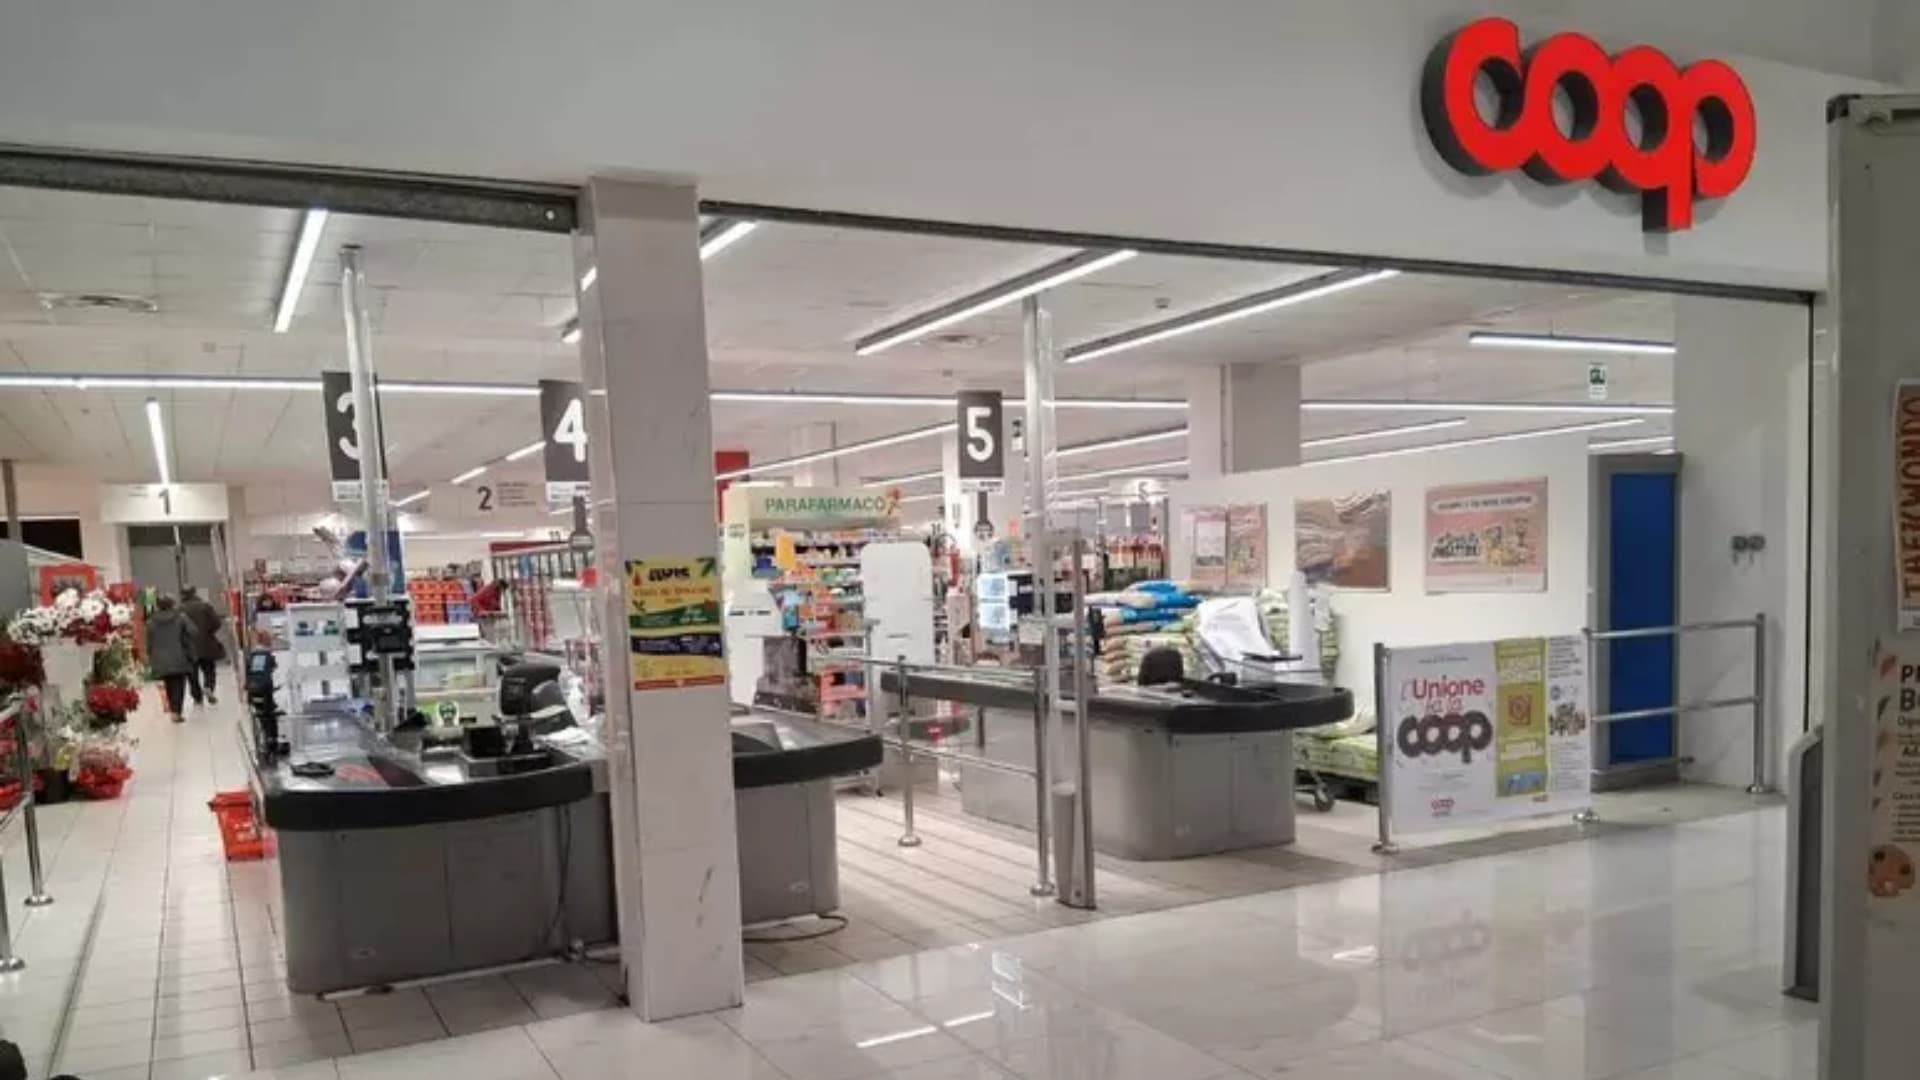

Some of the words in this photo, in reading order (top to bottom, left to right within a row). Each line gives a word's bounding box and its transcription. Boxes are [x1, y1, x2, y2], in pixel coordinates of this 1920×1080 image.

[1422, 16, 1757, 233] coop
[336, 391, 361, 461] 3
[553, 398, 588, 462] 4
[966, 406, 994, 462] 5
[158, 487, 171, 516] 1
[477, 485, 493, 512] 2
[765, 496, 887, 513] PARAFARMACO
[1398, 710, 1493, 765] coop
